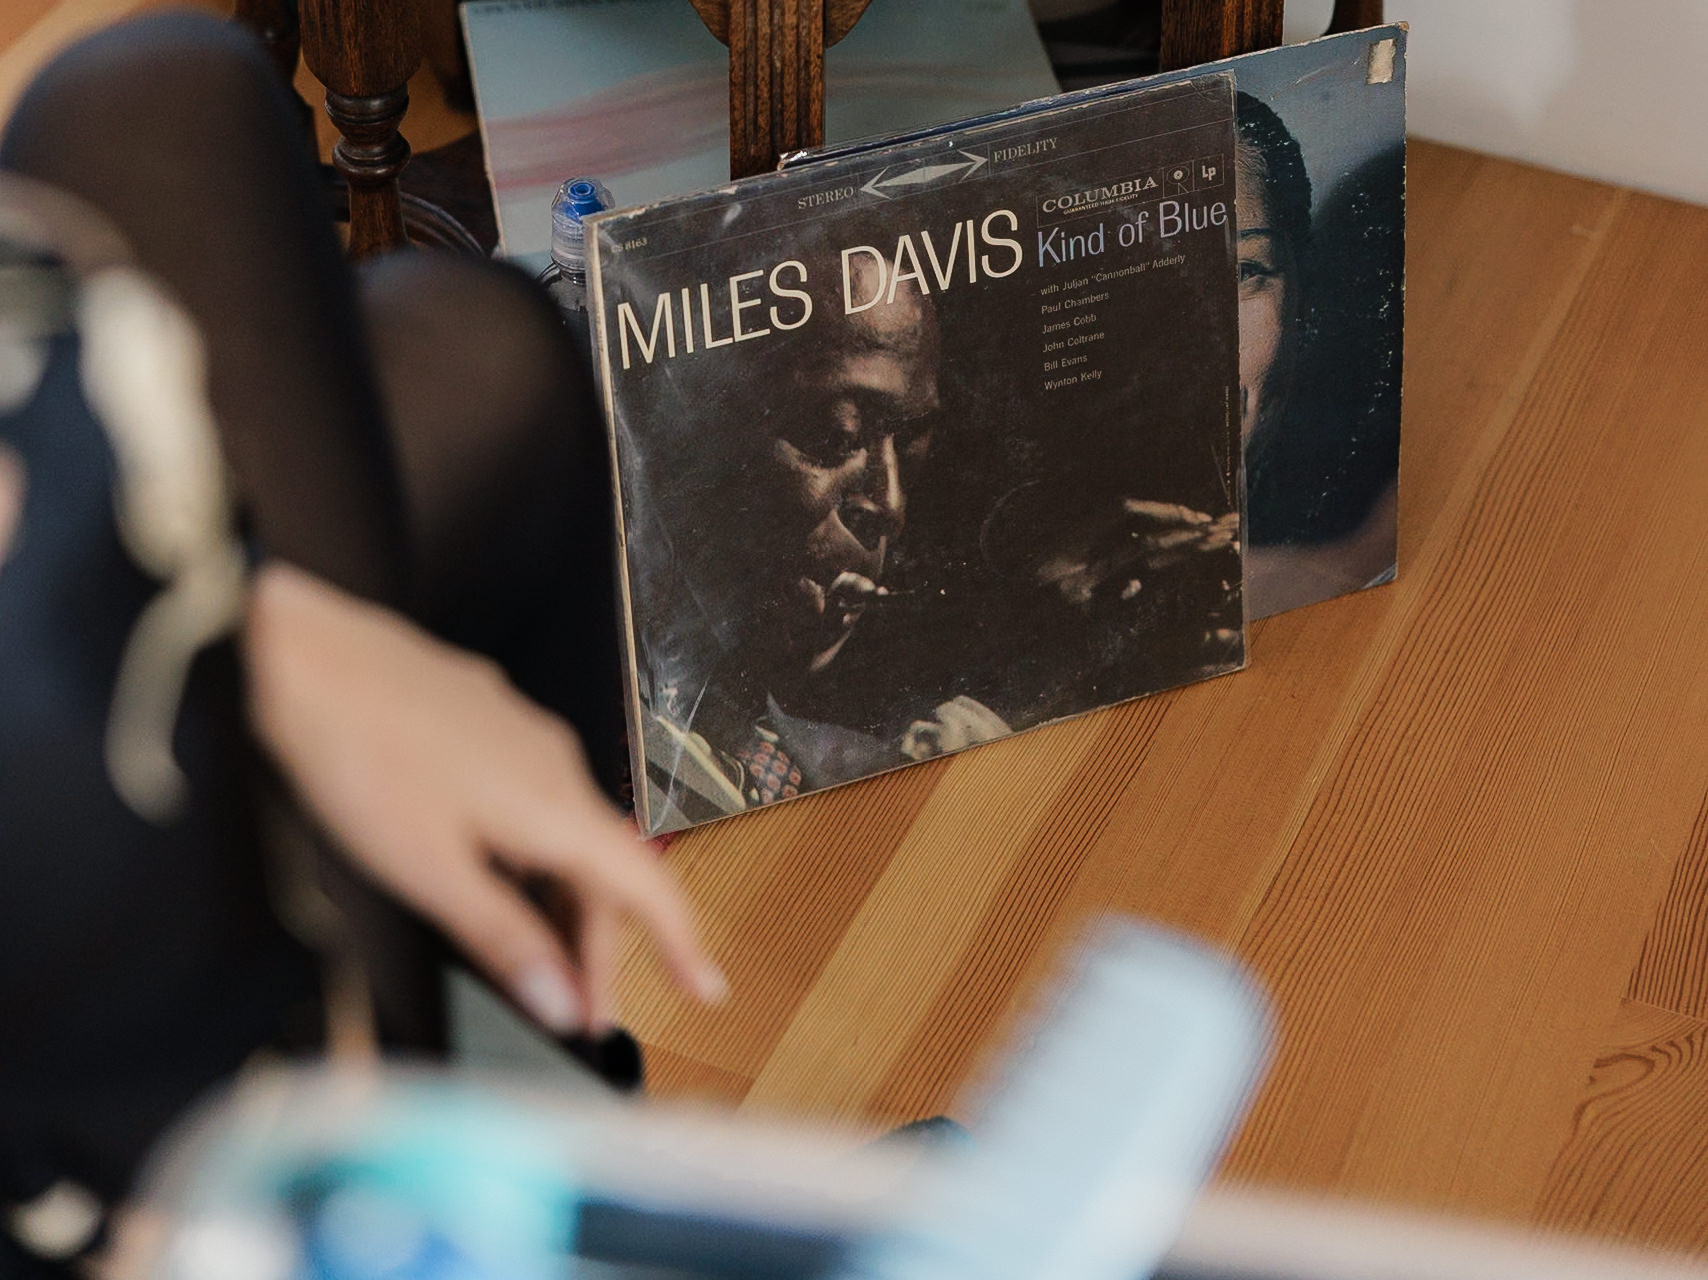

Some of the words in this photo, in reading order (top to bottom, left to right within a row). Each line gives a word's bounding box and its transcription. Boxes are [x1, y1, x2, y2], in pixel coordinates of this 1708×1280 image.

[993, 136, 1059, 164] FIDELITY
[797, 184, 855, 210] STEREO
[1042, 176, 1159, 213] COLUMBIA
[1037, 222, 1105, 268] Kind
[1118, 210, 1149, 247] of
[1159, 200, 1228, 239] Blue
[1040, 284, 1060, 296] with
[1062, 277, 1089, 291] Julian
[1152, 254, 1186, 269] Adderly
[616, 260, 813, 371] MILES
[840, 208, 1023, 315] DAVIS
[1041, 302, 1061, 314] Paul
[1064, 291, 1109, 309] Chambers
[1042, 321, 1071, 334] James
[1073, 313, 1097, 326] Cobb
[1042, 341, 1065, 353] John
[1067, 331, 1105, 347] Coltrane
[1043, 360, 1058, 372] Bill
[1061, 354, 1088, 368] Evans
[1044, 376, 1078, 391] Wynton
[1080, 369, 1103, 383] Kelly
